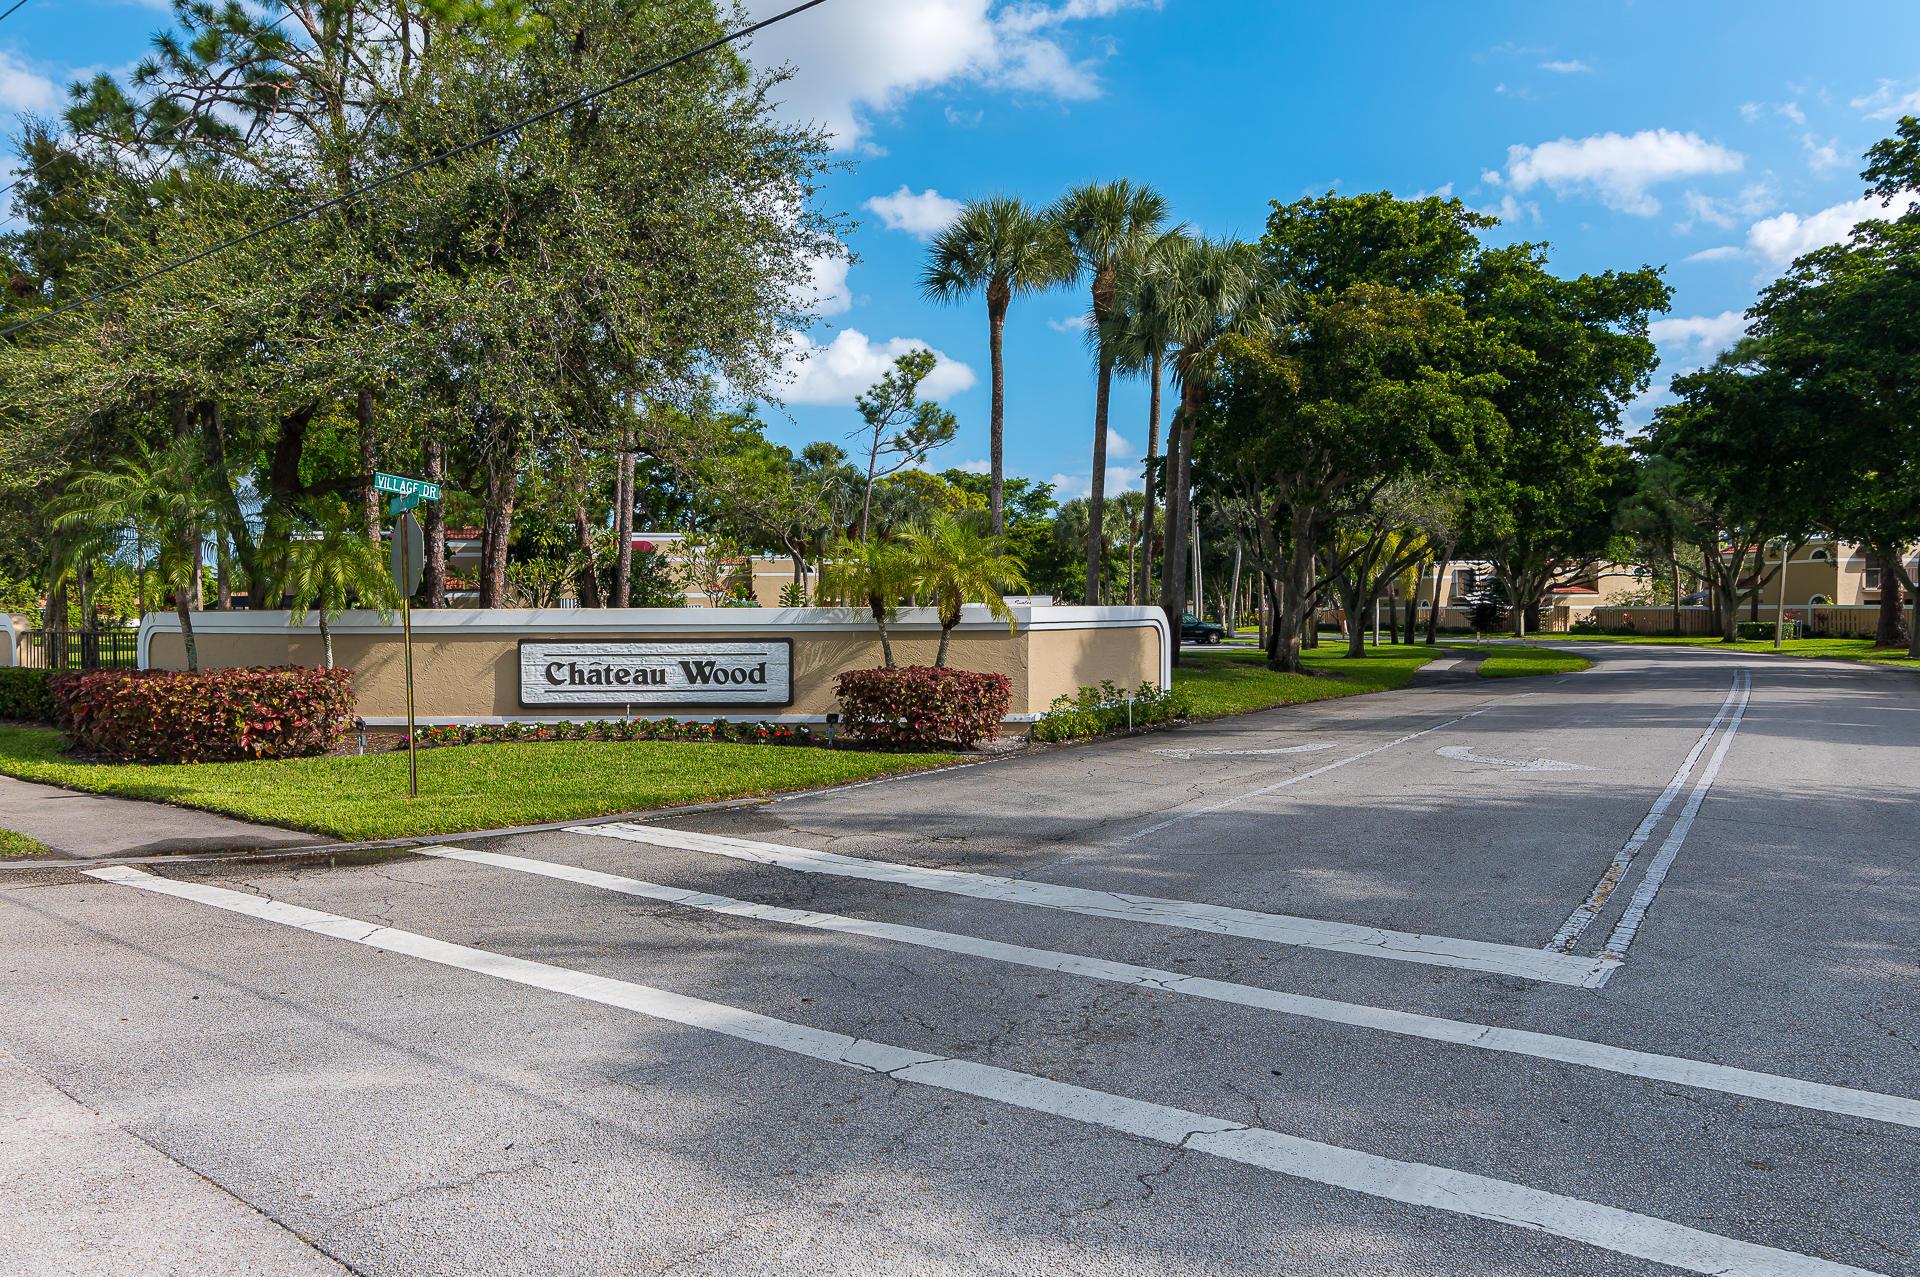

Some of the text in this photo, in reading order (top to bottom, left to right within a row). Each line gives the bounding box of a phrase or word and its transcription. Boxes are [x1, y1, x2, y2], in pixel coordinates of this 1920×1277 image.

[423, 484, 437, 498] DR
[545, 660, 768, 686] Château Wood
